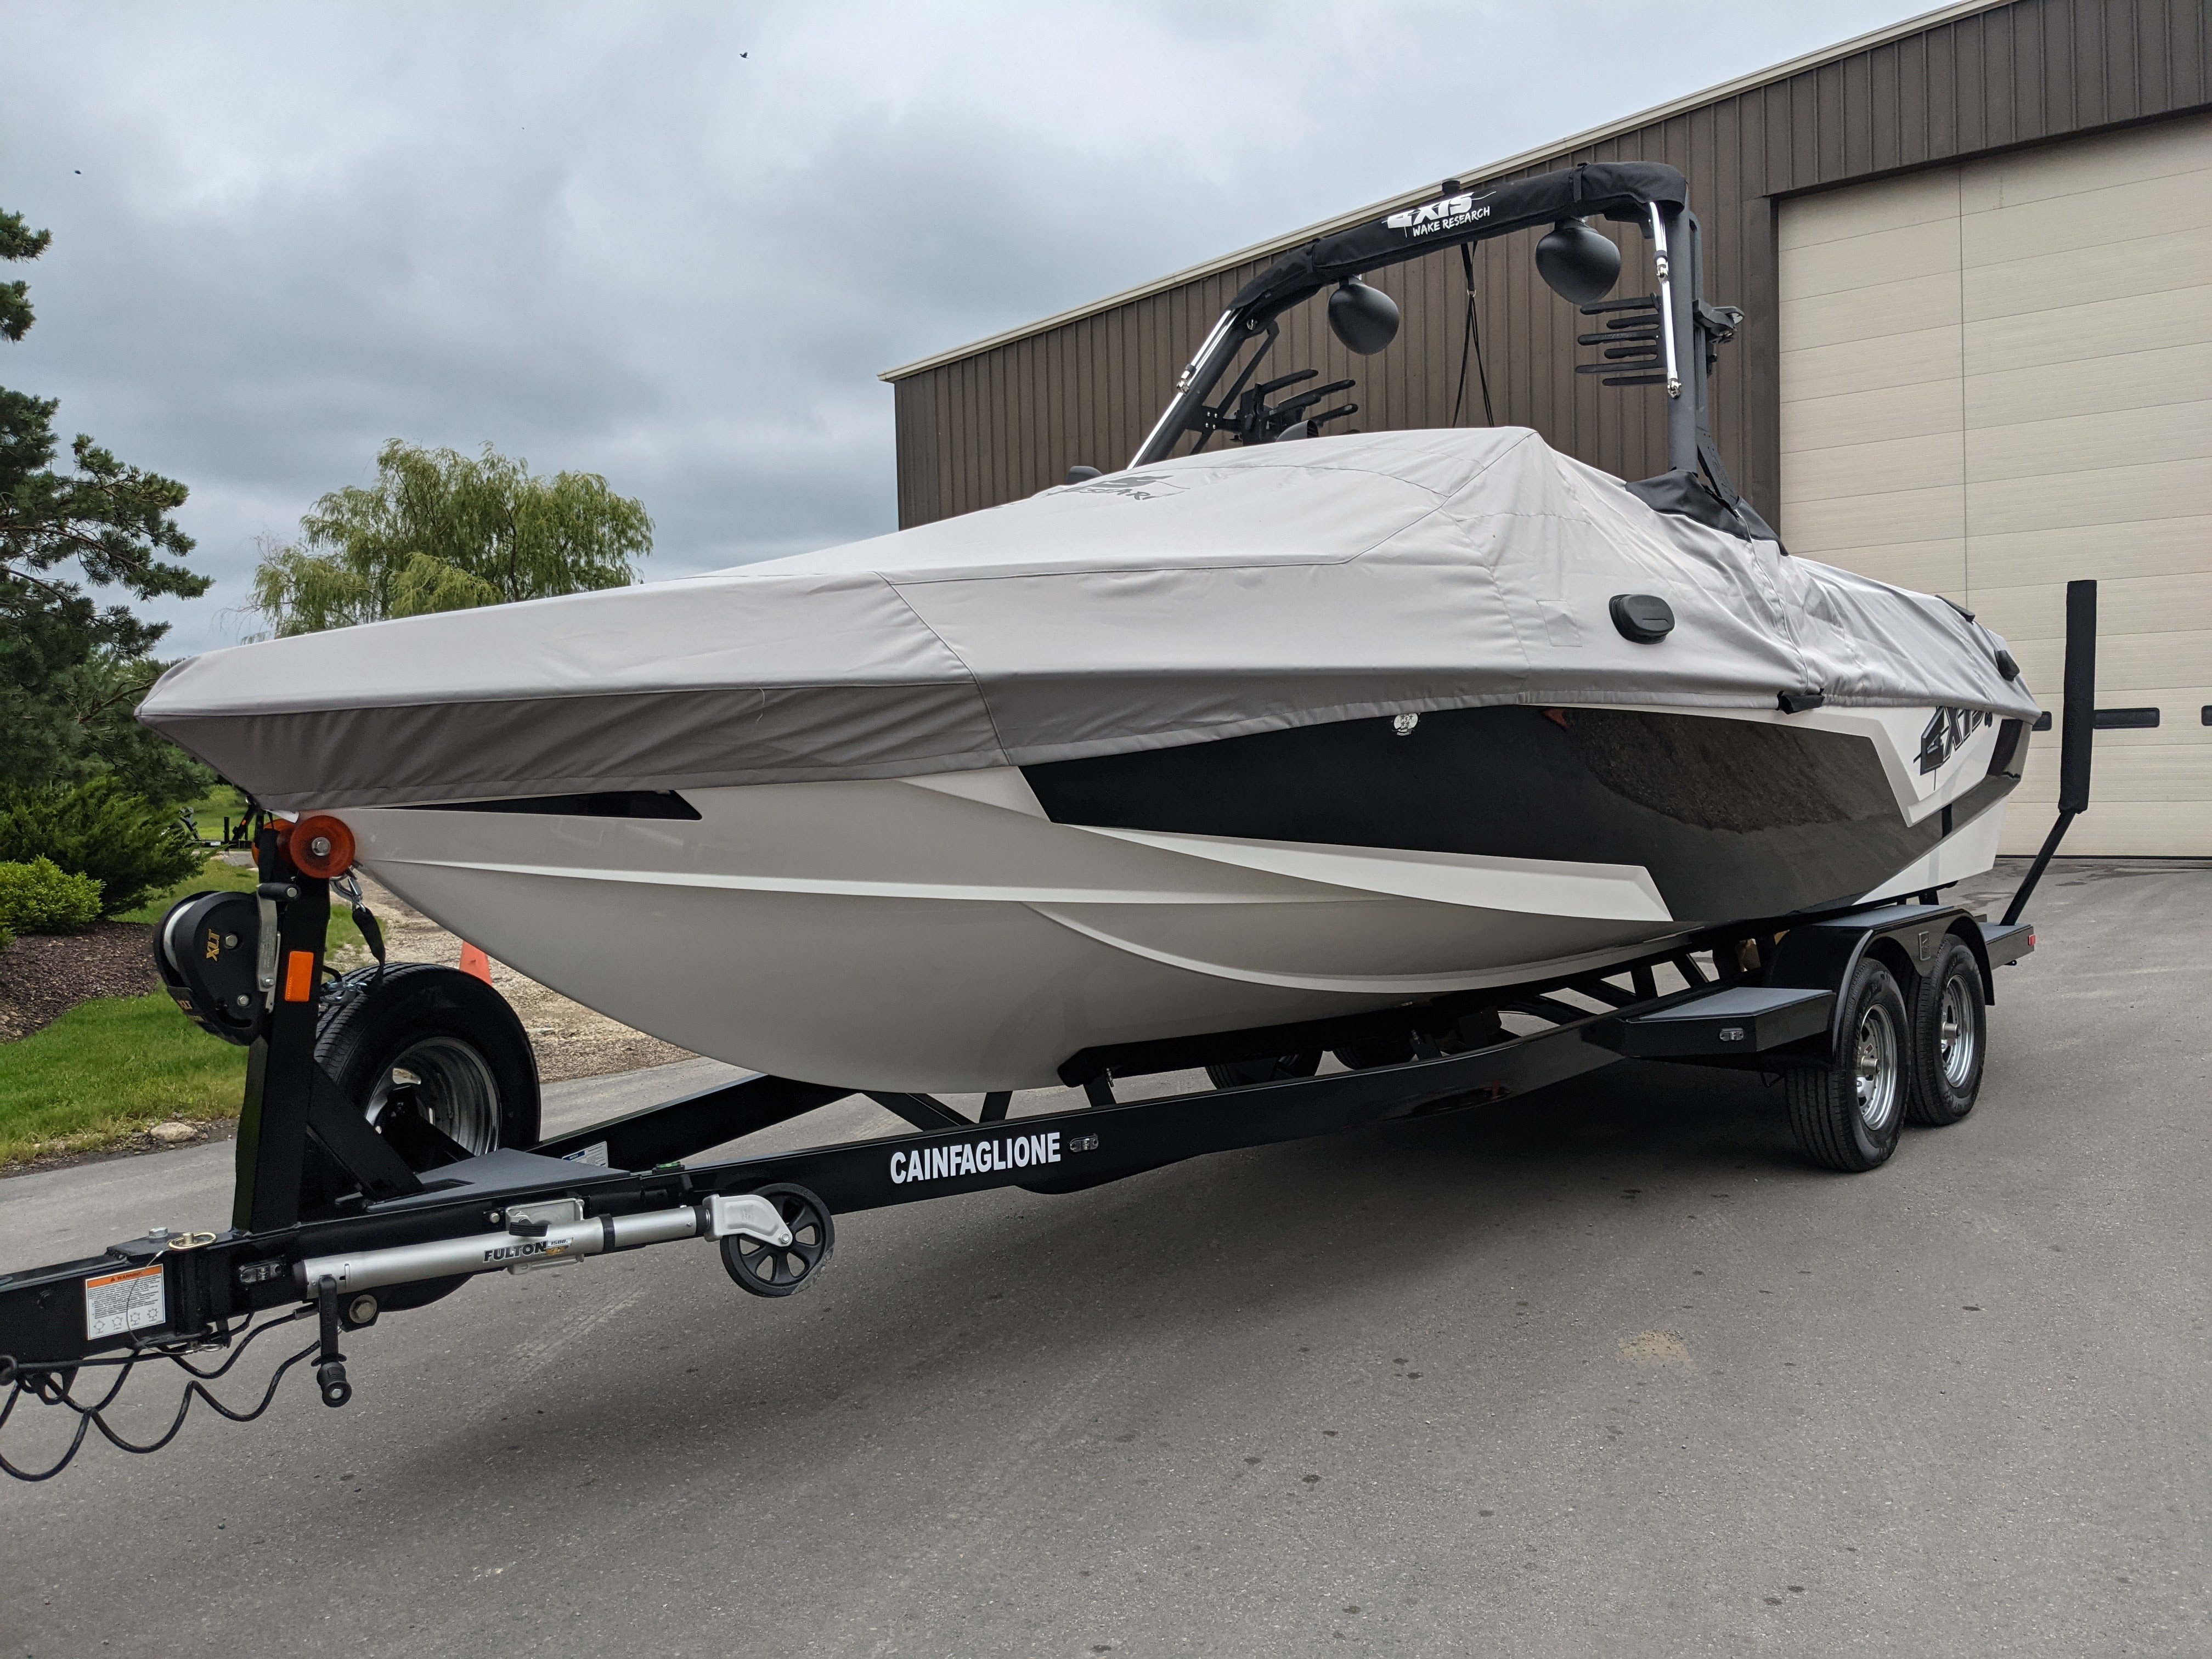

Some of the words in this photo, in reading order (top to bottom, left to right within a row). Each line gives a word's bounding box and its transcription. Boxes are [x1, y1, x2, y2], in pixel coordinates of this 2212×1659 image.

[1413, 221, 1441, 237] WAKE
[1442, 206, 1490, 229] RESEARCH
[206, 928, 220, 962] XLT
[890, 1132, 1061, 1184] CAINFAGLIONE
[483, 1240, 548, 1262] FULTON
